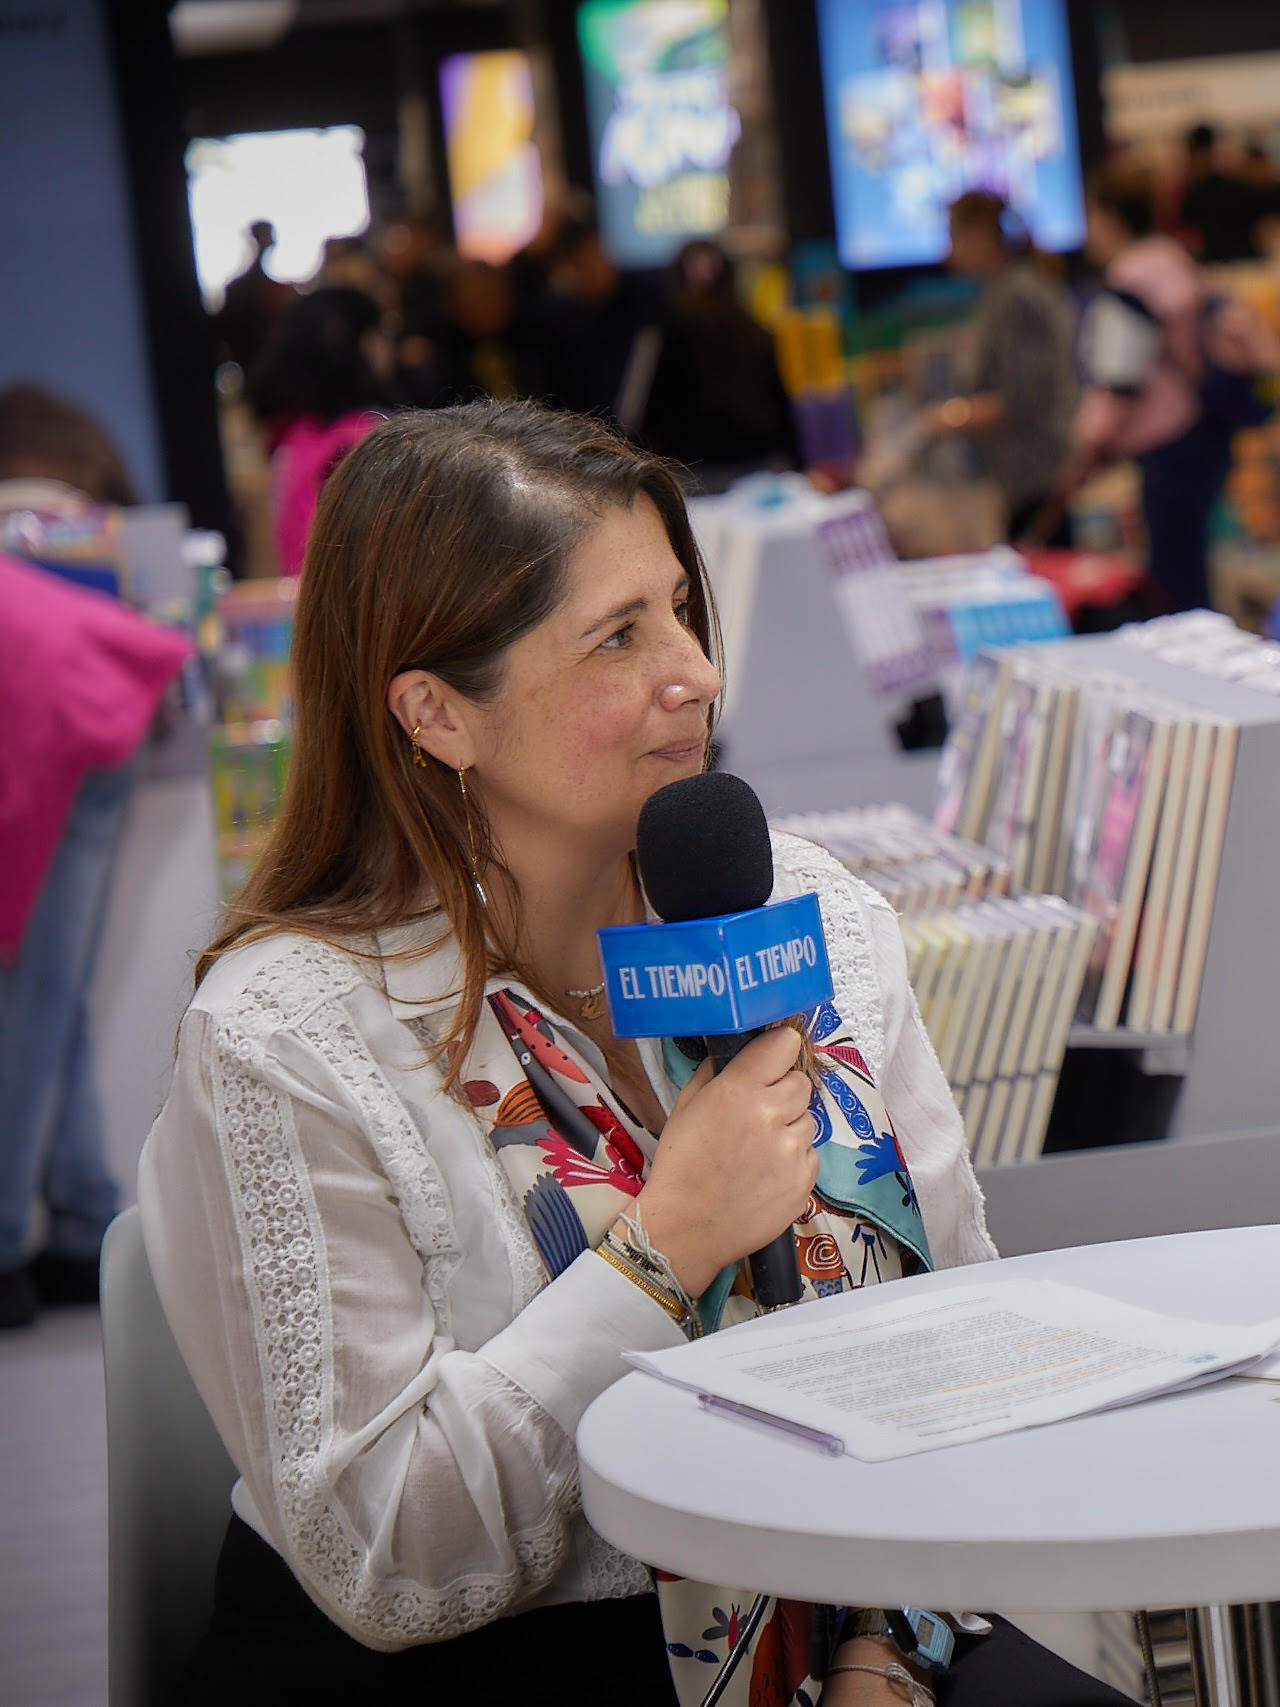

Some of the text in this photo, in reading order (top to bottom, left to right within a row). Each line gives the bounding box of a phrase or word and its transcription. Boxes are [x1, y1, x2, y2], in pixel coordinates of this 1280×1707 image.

[619, 964, 725, 999] EL TIEMPO
[736, 935, 816, 990] EL TIEMPO
